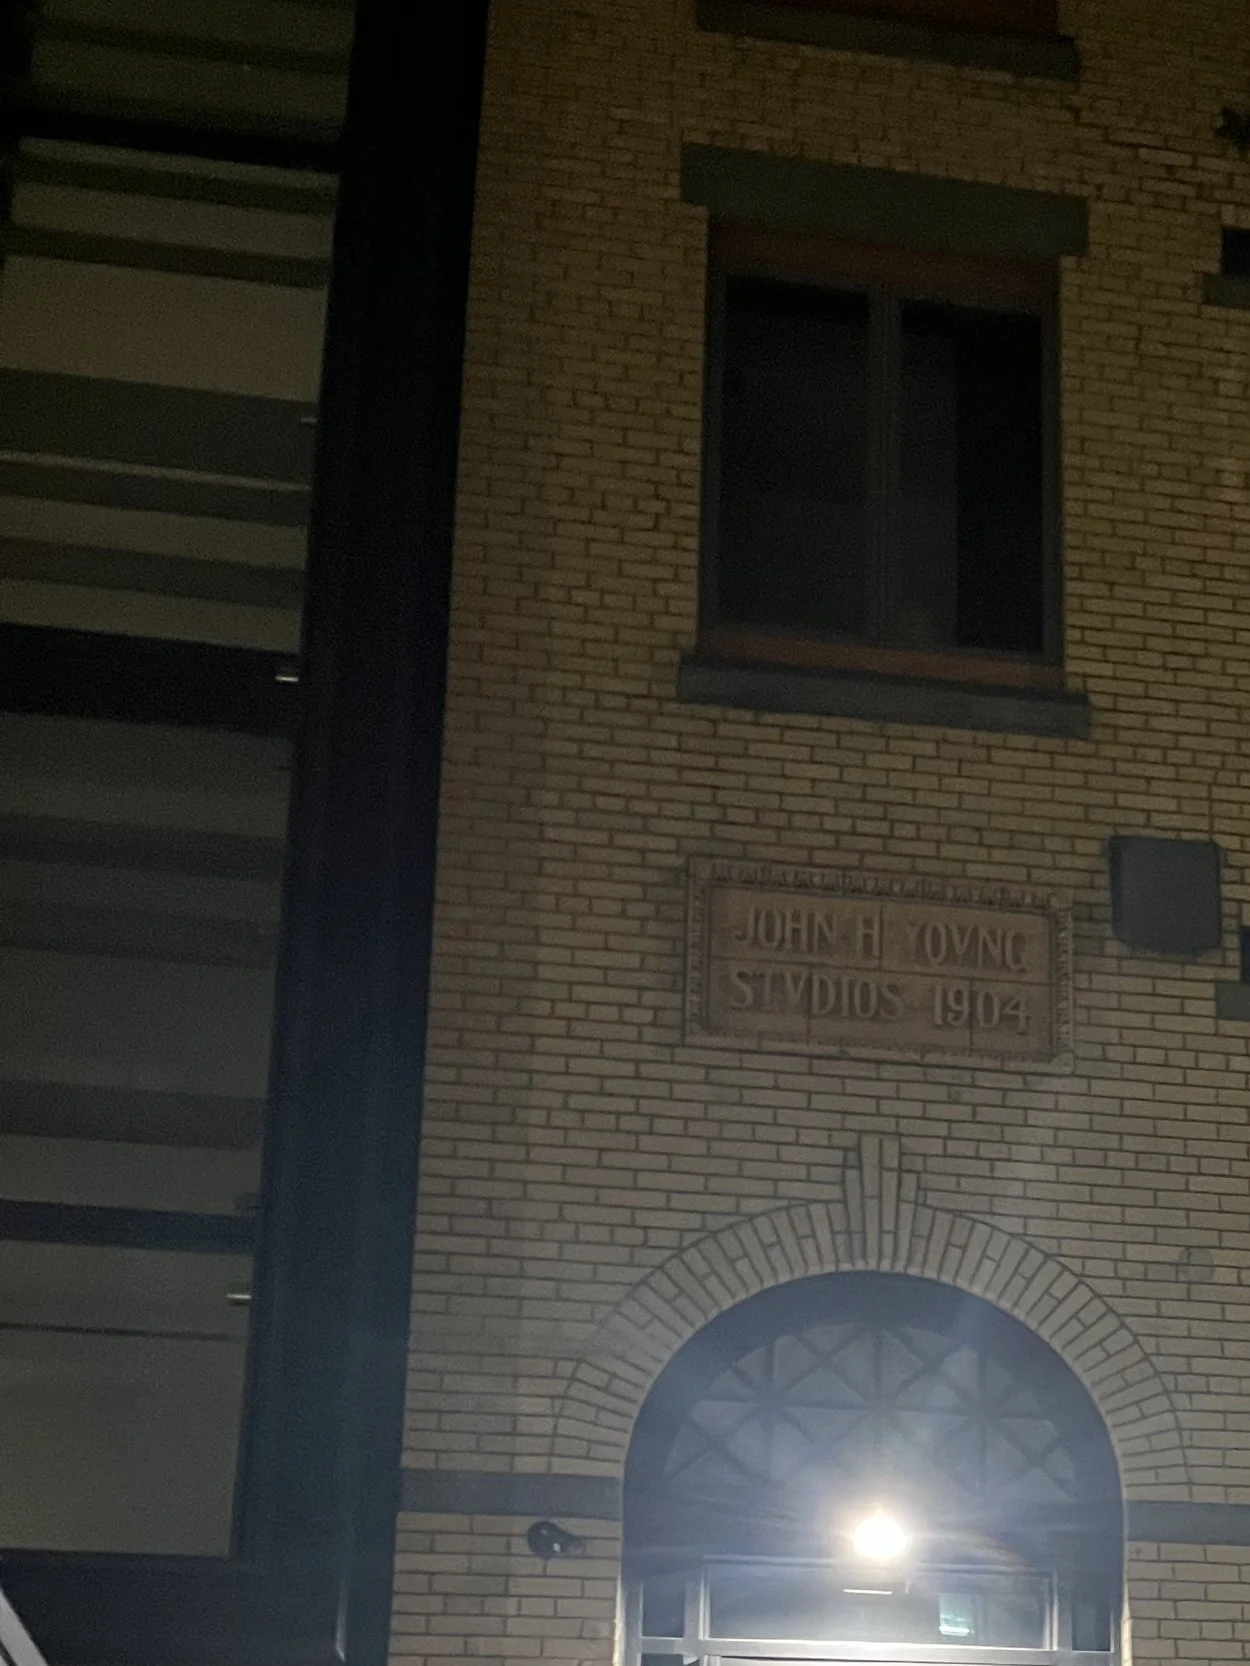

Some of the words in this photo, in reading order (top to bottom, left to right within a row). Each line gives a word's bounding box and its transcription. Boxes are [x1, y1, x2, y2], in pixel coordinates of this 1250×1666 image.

[734, 906, 838, 953] JOHN
[855, 914, 881, 958] H
[729, 967, 904, 1021] STVDIOS
[931, 981, 1033, 1036] 1904
